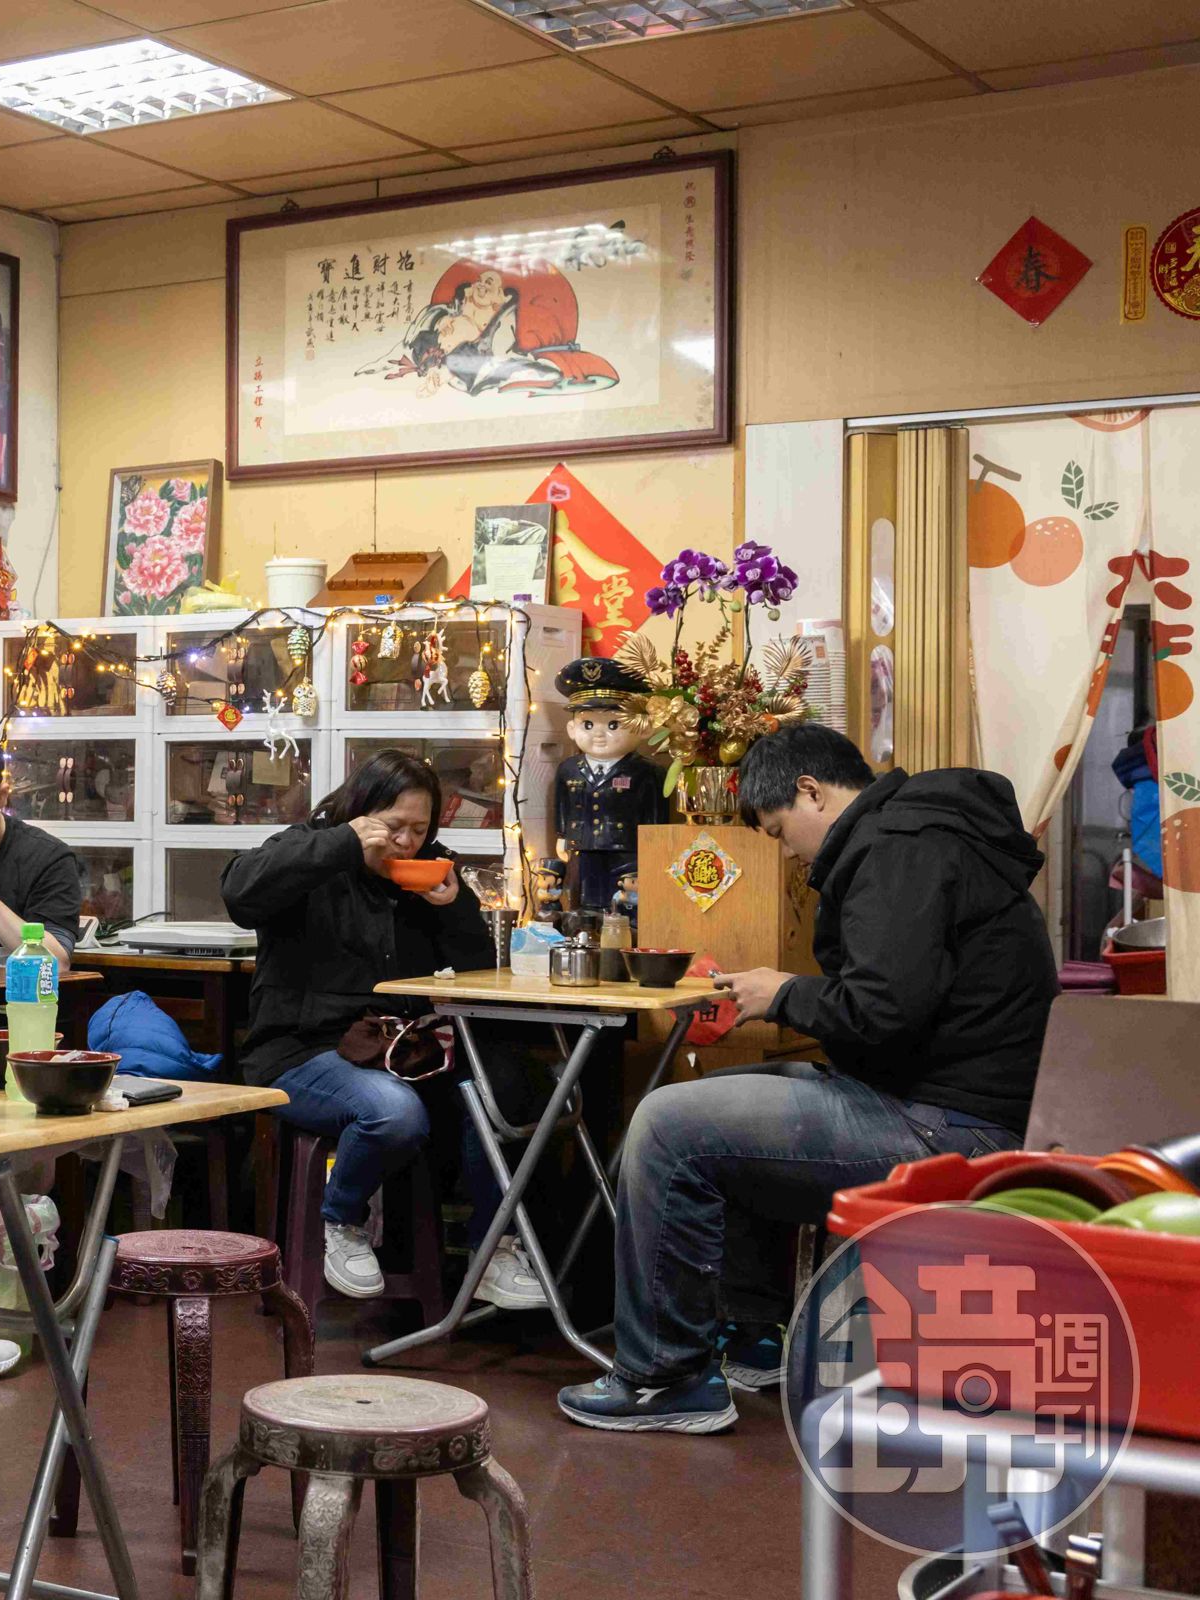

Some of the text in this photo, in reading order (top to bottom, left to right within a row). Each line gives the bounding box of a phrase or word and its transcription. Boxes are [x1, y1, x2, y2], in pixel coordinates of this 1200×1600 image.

[317, 249, 415, 284] 招財進寶
[593, 575, 634, 628] 堂
